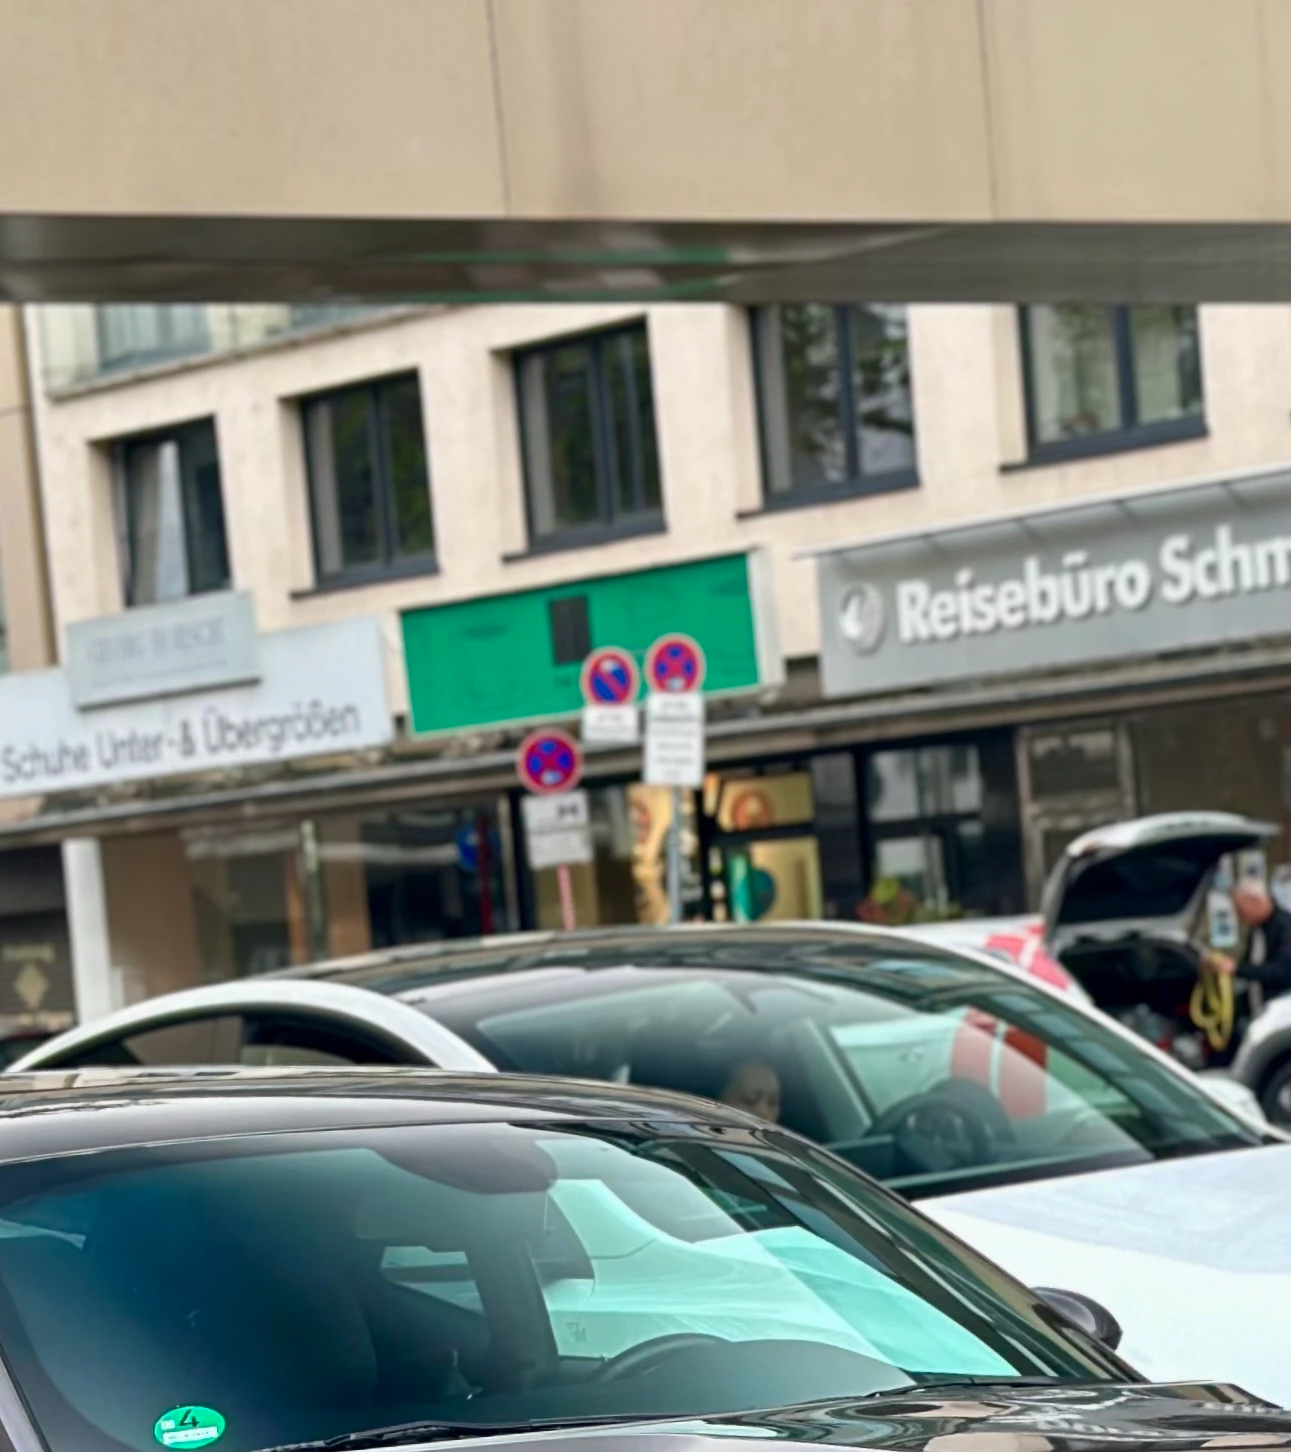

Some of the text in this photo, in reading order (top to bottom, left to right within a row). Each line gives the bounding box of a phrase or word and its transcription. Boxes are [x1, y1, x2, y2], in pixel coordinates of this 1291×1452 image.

[896, 550, 1154, 644] Reisebüro
[0, 738, 91, 783] Schuhe
[203, 698, 361, 756] Übergrößen
[179, 1409, 200, 1427] 4
